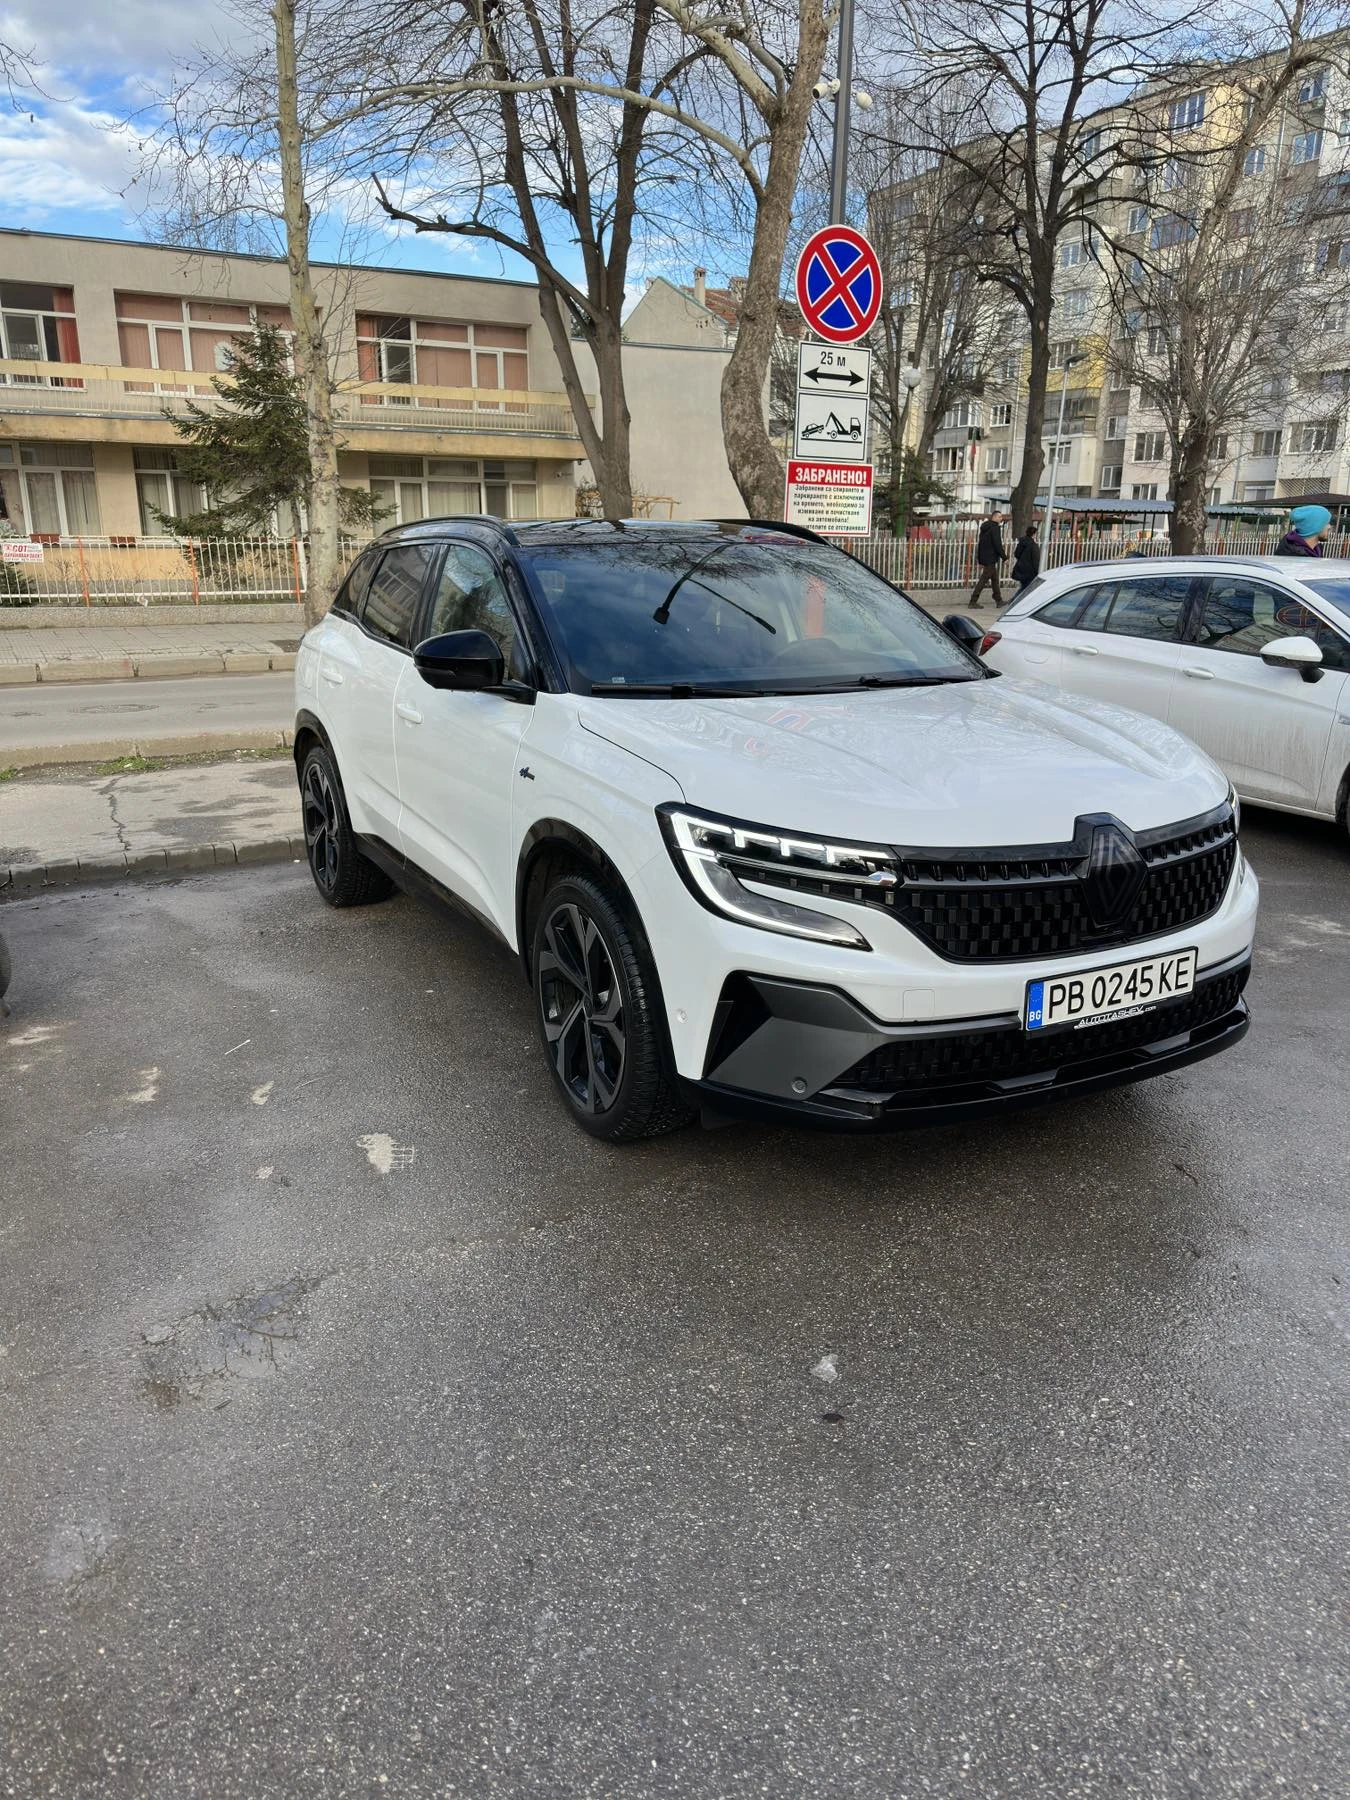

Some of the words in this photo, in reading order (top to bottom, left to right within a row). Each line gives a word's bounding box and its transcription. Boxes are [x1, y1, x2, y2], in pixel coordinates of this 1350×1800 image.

[820, 351, 833, 365] 25
[795, 467, 867, 485] ЗАБРАНЕНО!
[1048, 980, 1084, 1019] PB
[1091, 964, 1154, 1009] 0245
[1158, 956, 1190, 994] KE
[1028, 1009, 1042, 1022] BG
